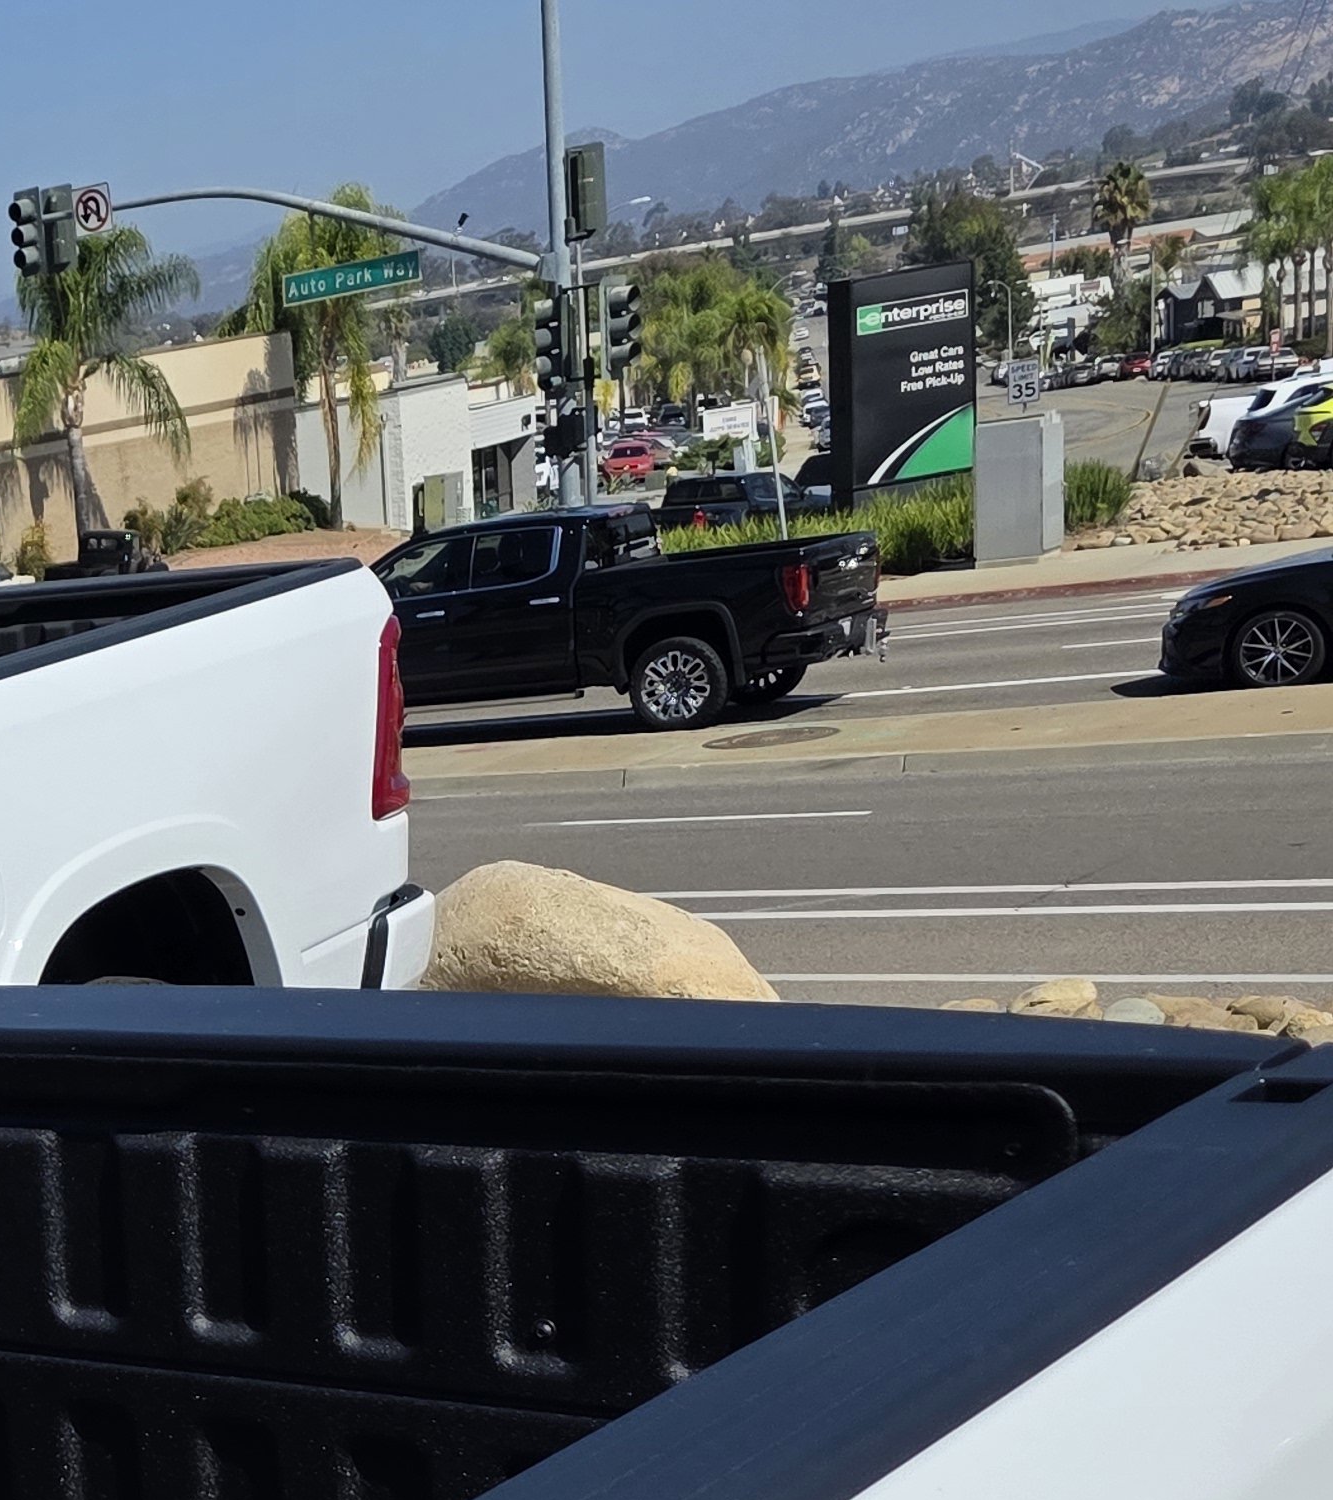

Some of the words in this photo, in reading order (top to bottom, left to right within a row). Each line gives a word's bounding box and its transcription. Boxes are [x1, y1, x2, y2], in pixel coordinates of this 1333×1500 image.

[287, 281, 327, 298] Auto
[335, 267, 372, 289] Park
[383, 260, 416, 280] Way
[865, 297, 966, 327] enterprise
[909, 348, 939, 363] Great
[939, 345, 965, 358] Cars
[911, 364, 934, 378] Low
[935, 359, 965, 373] Rates
[1011, 363, 1038, 374] SPEED
[900, 380, 924, 393] Free
[925, 372, 965, 389] Pick-Up
[1012, 381, 1036, 400] 35
